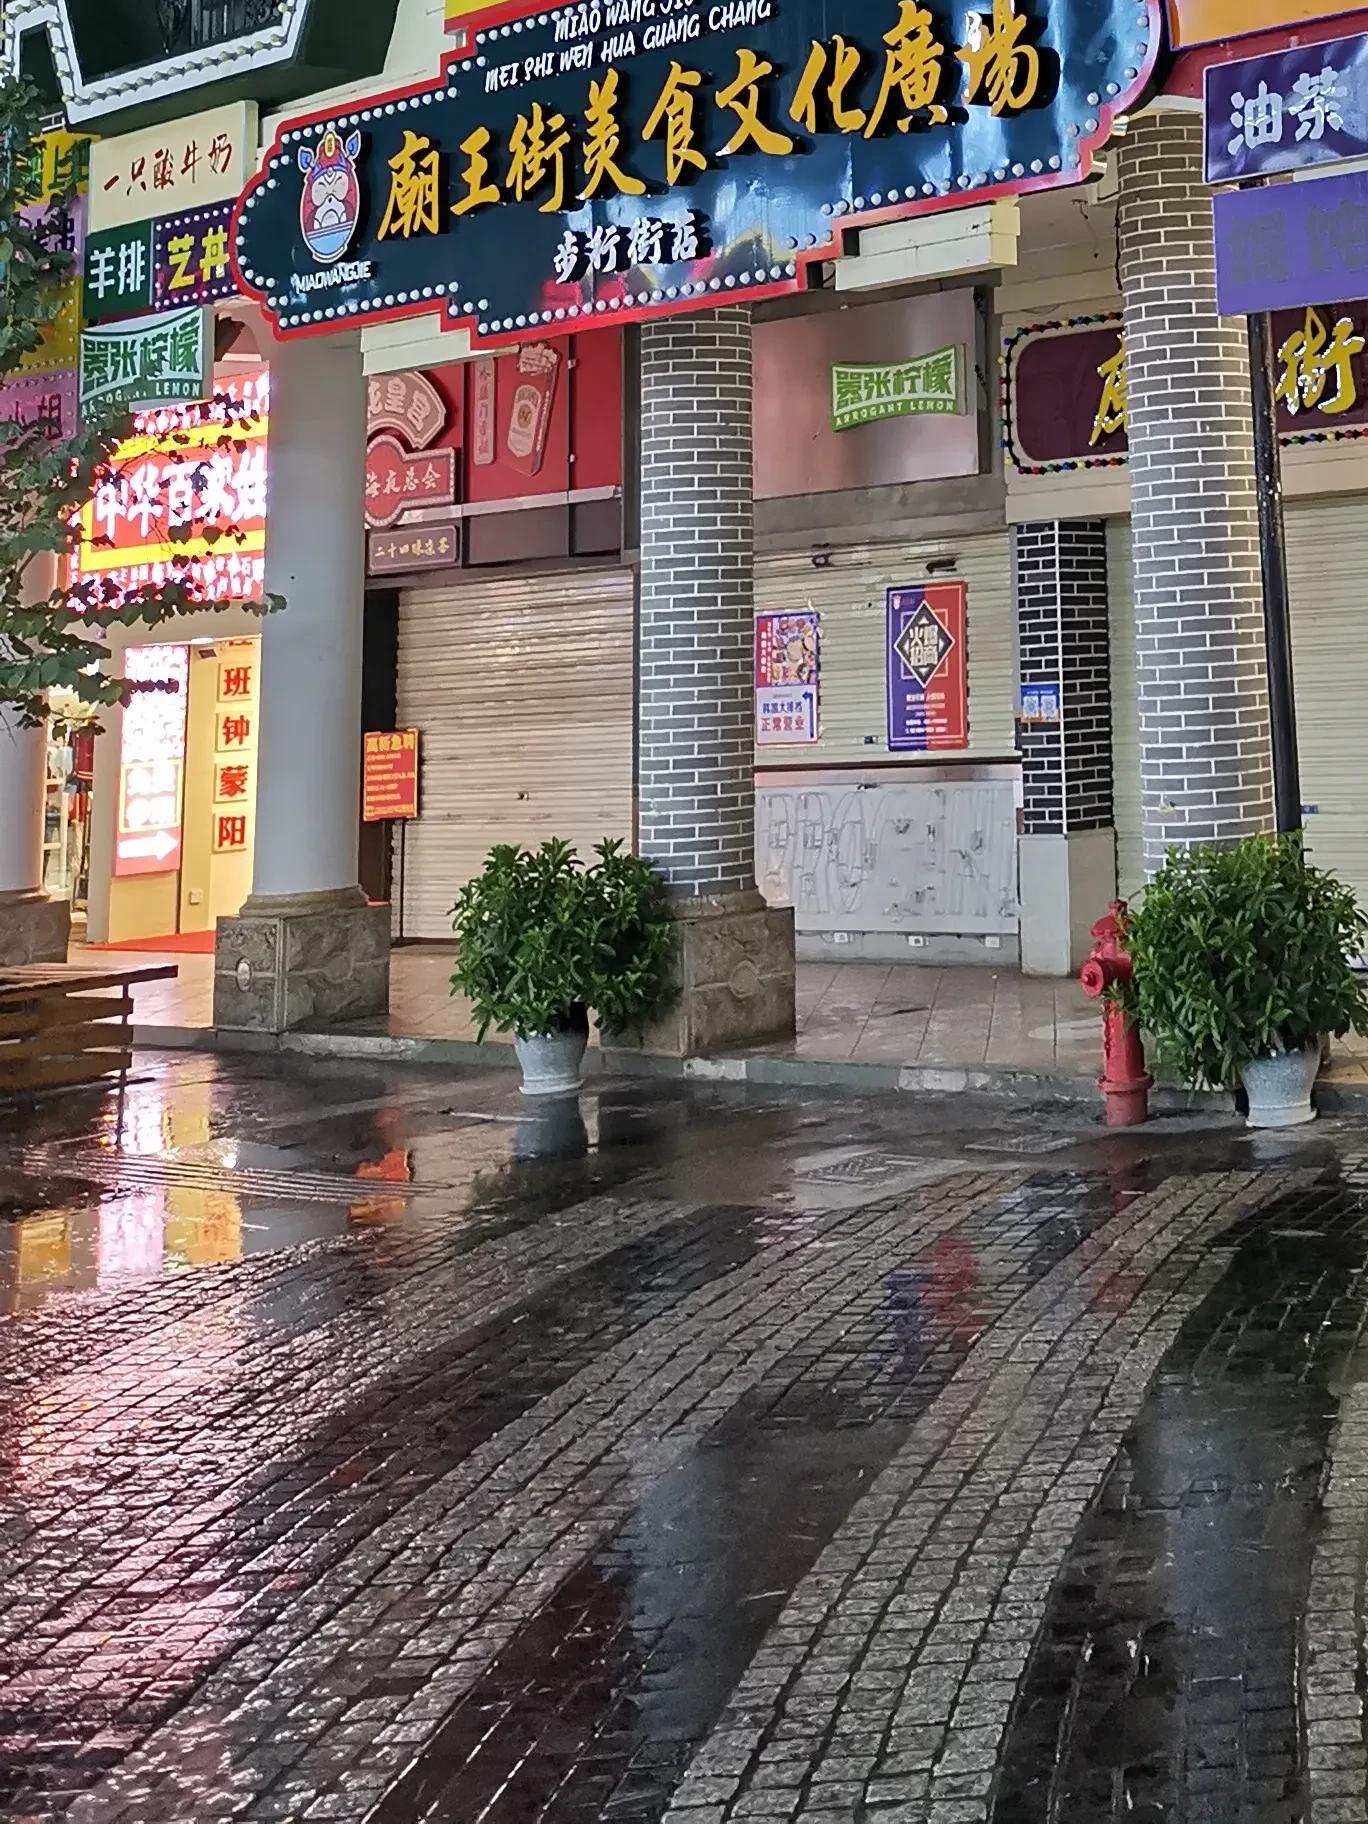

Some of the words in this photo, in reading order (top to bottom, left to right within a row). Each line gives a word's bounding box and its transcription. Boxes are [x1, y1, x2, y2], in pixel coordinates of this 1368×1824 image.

[485, 57, 518, 93] MEI
[560, 42, 593, 71] WEN
[601, 33, 636, 64] HUA
[643, 13, 700, 50] GUANG
[554, 9, 601, 42] MIAO
[1227, 66, 1347, 153] 油茶
[89, 240, 145, 298] 羊排
[156, 382, 200, 395] LEMON
